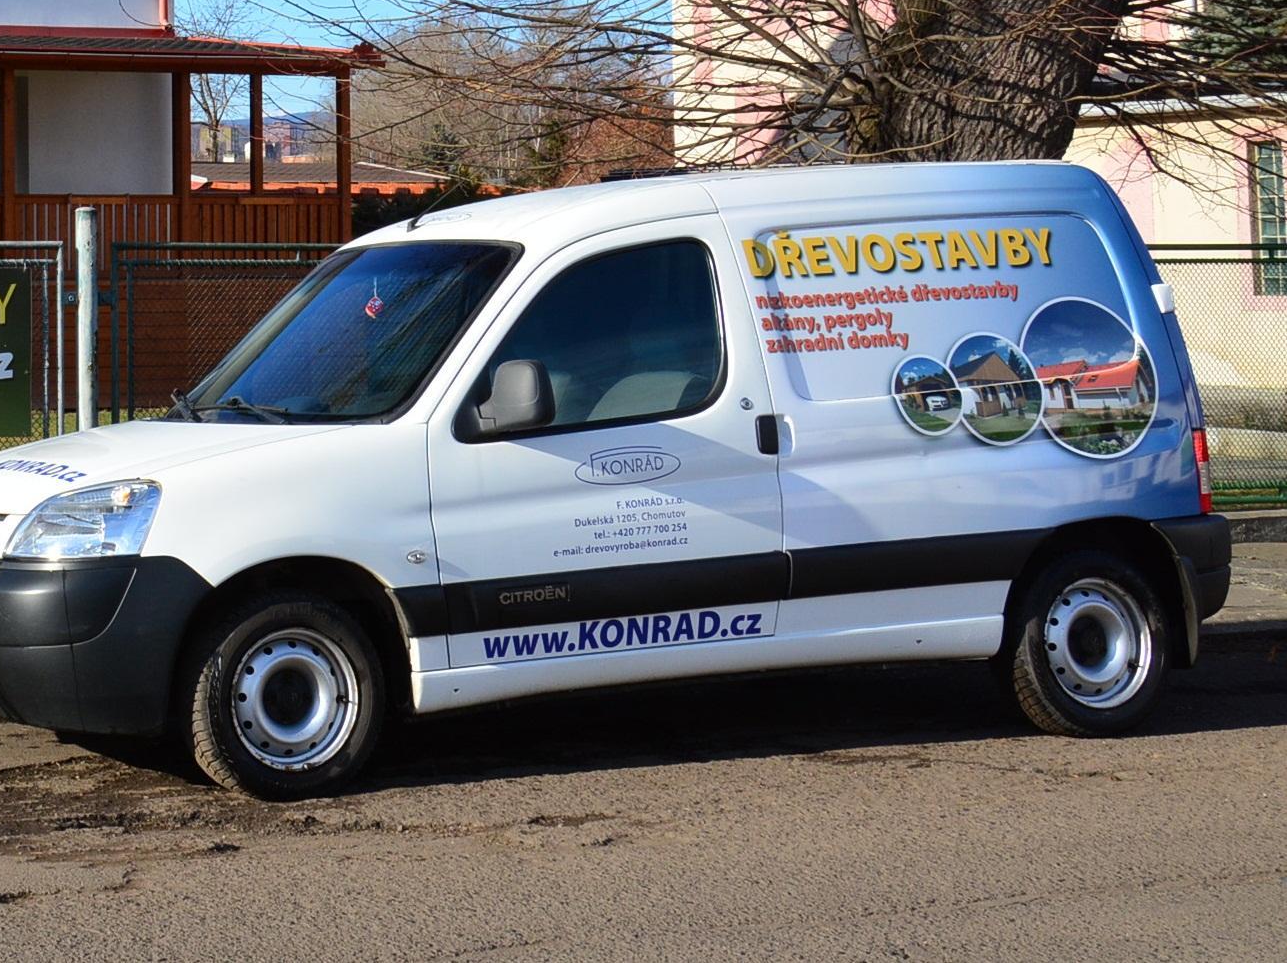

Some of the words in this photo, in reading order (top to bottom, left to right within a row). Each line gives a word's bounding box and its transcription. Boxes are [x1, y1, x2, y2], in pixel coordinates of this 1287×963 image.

[742, 227, 1052, 277] DŘEVOSTAVBY
[755, 285, 909, 310] nízkoenergetické
[910, 280, 1019, 302] dřevostavby
[761, 312, 821, 335] altány,
[823, 308, 893, 334] pergoly
[766, 333, 845, 354] zahradní
[847, 329, 910, 351] domky
[616, 500, 625, 510] F.
[625, 496, 664, 509] KONRÁD
[664, 497, 685, 506] s.r.o.
[574, 515, 614, 528] Dukelská
[616, 512, 640, 524] 1205,
[641, 510, 687, 522] Chomutov
[593, 529, 611, 540] tel.:
[612, 527, 634, 538] +420
[635, 525, 652, 536] 777
[653, 523, 670, 534] 700
[671, 521, 688, 533] 254
[553, 545, 584, 557] e-mail:
[585, 536, 688, 553] drevovyroba@konrad.cz
[499, 585, 567, 605] CITROËN
[483, 610, 763, 659] www.KONRAD.cz
